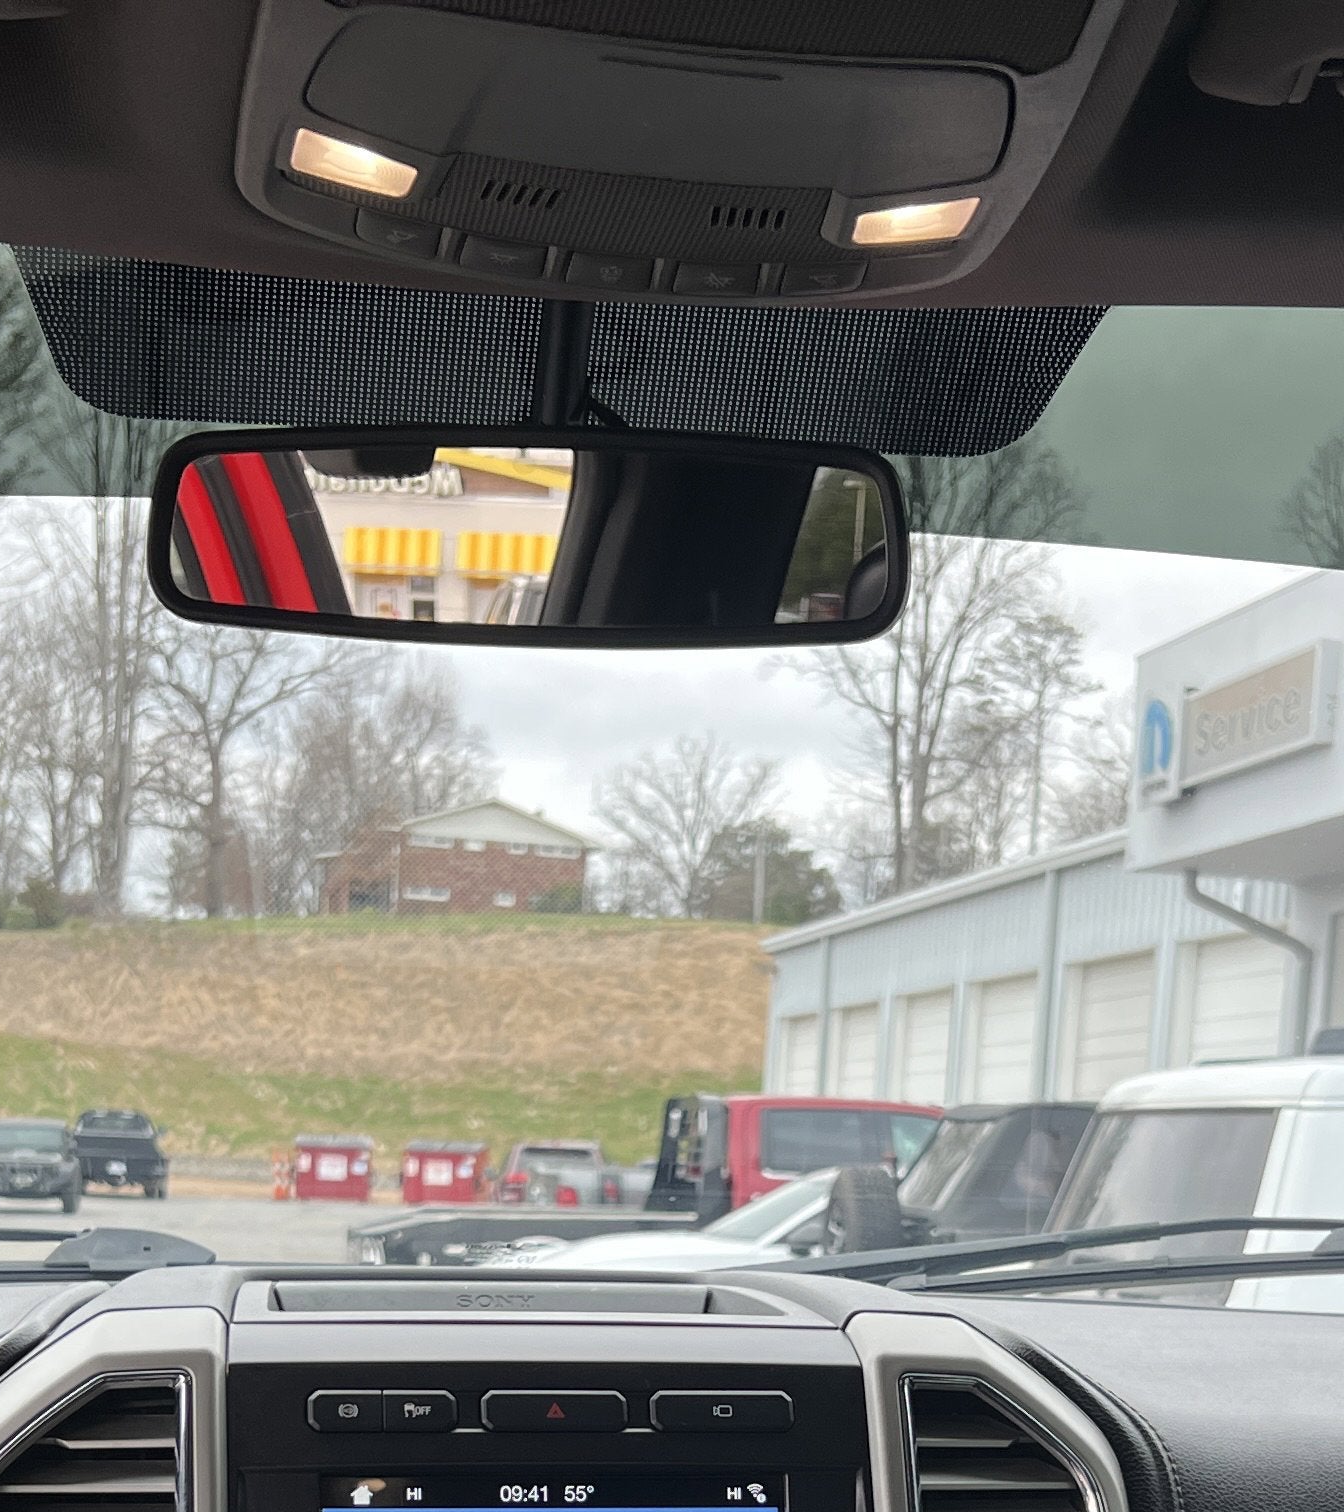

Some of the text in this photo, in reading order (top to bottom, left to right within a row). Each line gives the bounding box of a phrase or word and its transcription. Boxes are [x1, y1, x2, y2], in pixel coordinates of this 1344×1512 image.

[1194, 687, 1302, 755] Service
[456, 1294, 535, 1308] SONY
[416, 1405, 431, 1416] OFF
[406, 1487, 423, 1501] HI
[499, 1484, 595, 1502] 09:41 55°
[726, 1486, 742, 1500] HI
